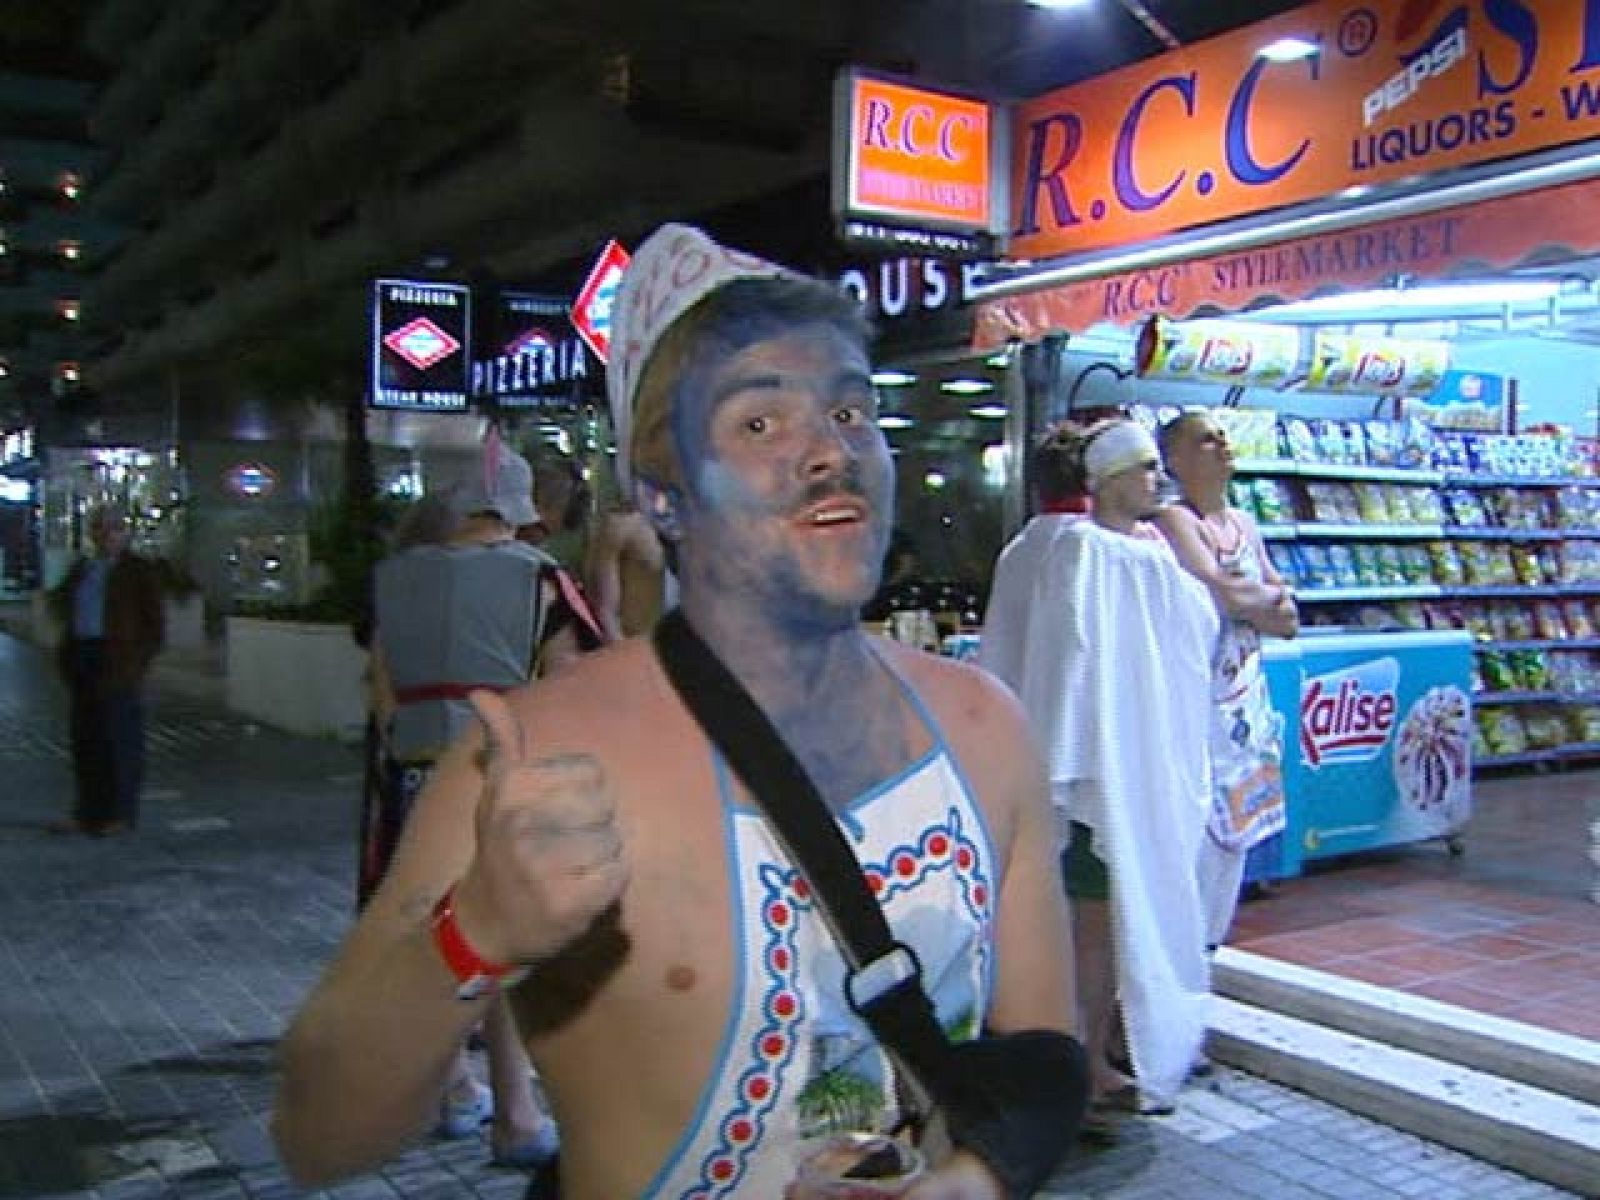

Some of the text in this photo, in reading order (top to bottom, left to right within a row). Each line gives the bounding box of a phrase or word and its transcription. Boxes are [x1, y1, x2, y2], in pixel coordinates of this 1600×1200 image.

[1362, 27, 1467, 128] PEPSI
[1351, 101, 1516, 171] LIQUORS
[472, 338, 586, 396] PIZZERIA
